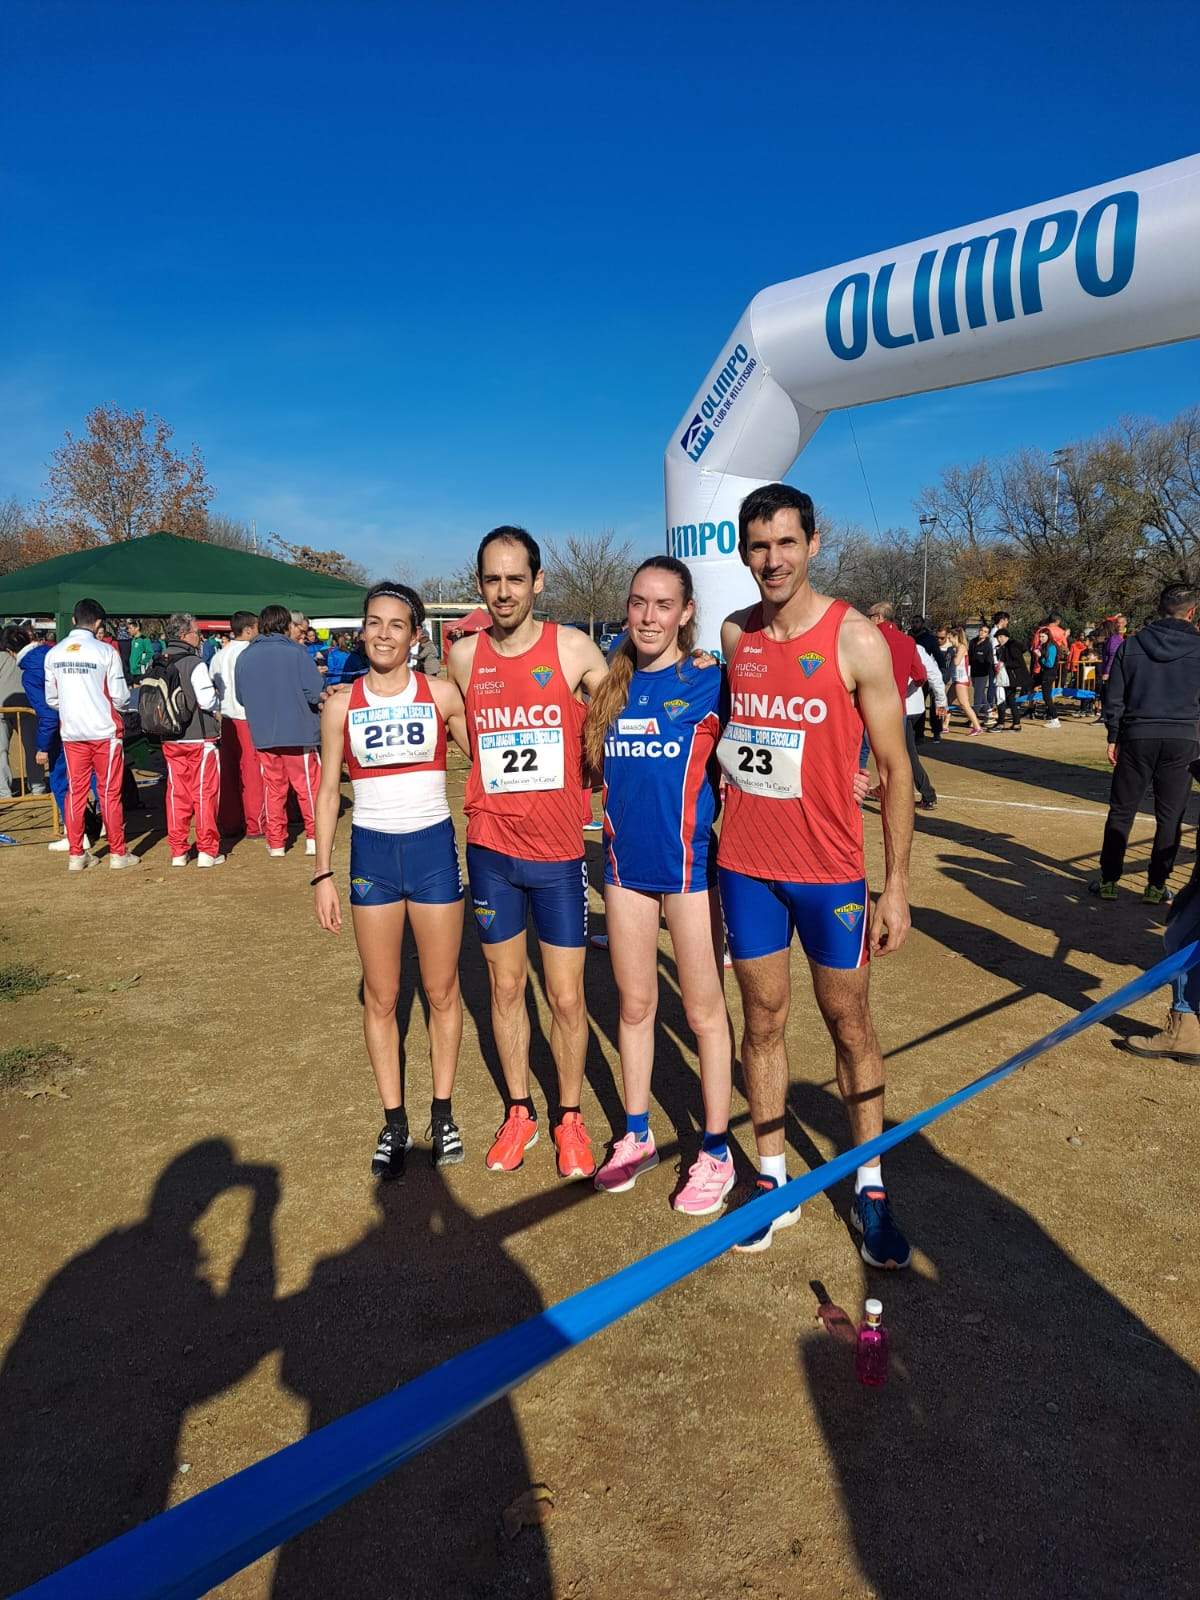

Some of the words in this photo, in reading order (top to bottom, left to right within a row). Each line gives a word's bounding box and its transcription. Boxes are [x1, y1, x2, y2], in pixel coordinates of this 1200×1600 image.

[825, 190, 1139, 361] OLIMPO
[701, 343, 748, 420] OLIMPO
[713, 410, 727, 428] CLUB
[724, 399, 734, 411] DE
[730, 358, 757, 400] ATLETISMO
[666, 520, 736, 558] IMPO
[365, 721, 425, 750] 228
[756, 730, 770, 746] COPA
[770, 731, 799, 748] ESCOLAR
[502, 748, 539, 774] 22
[737, 746, 773, 775] 23
